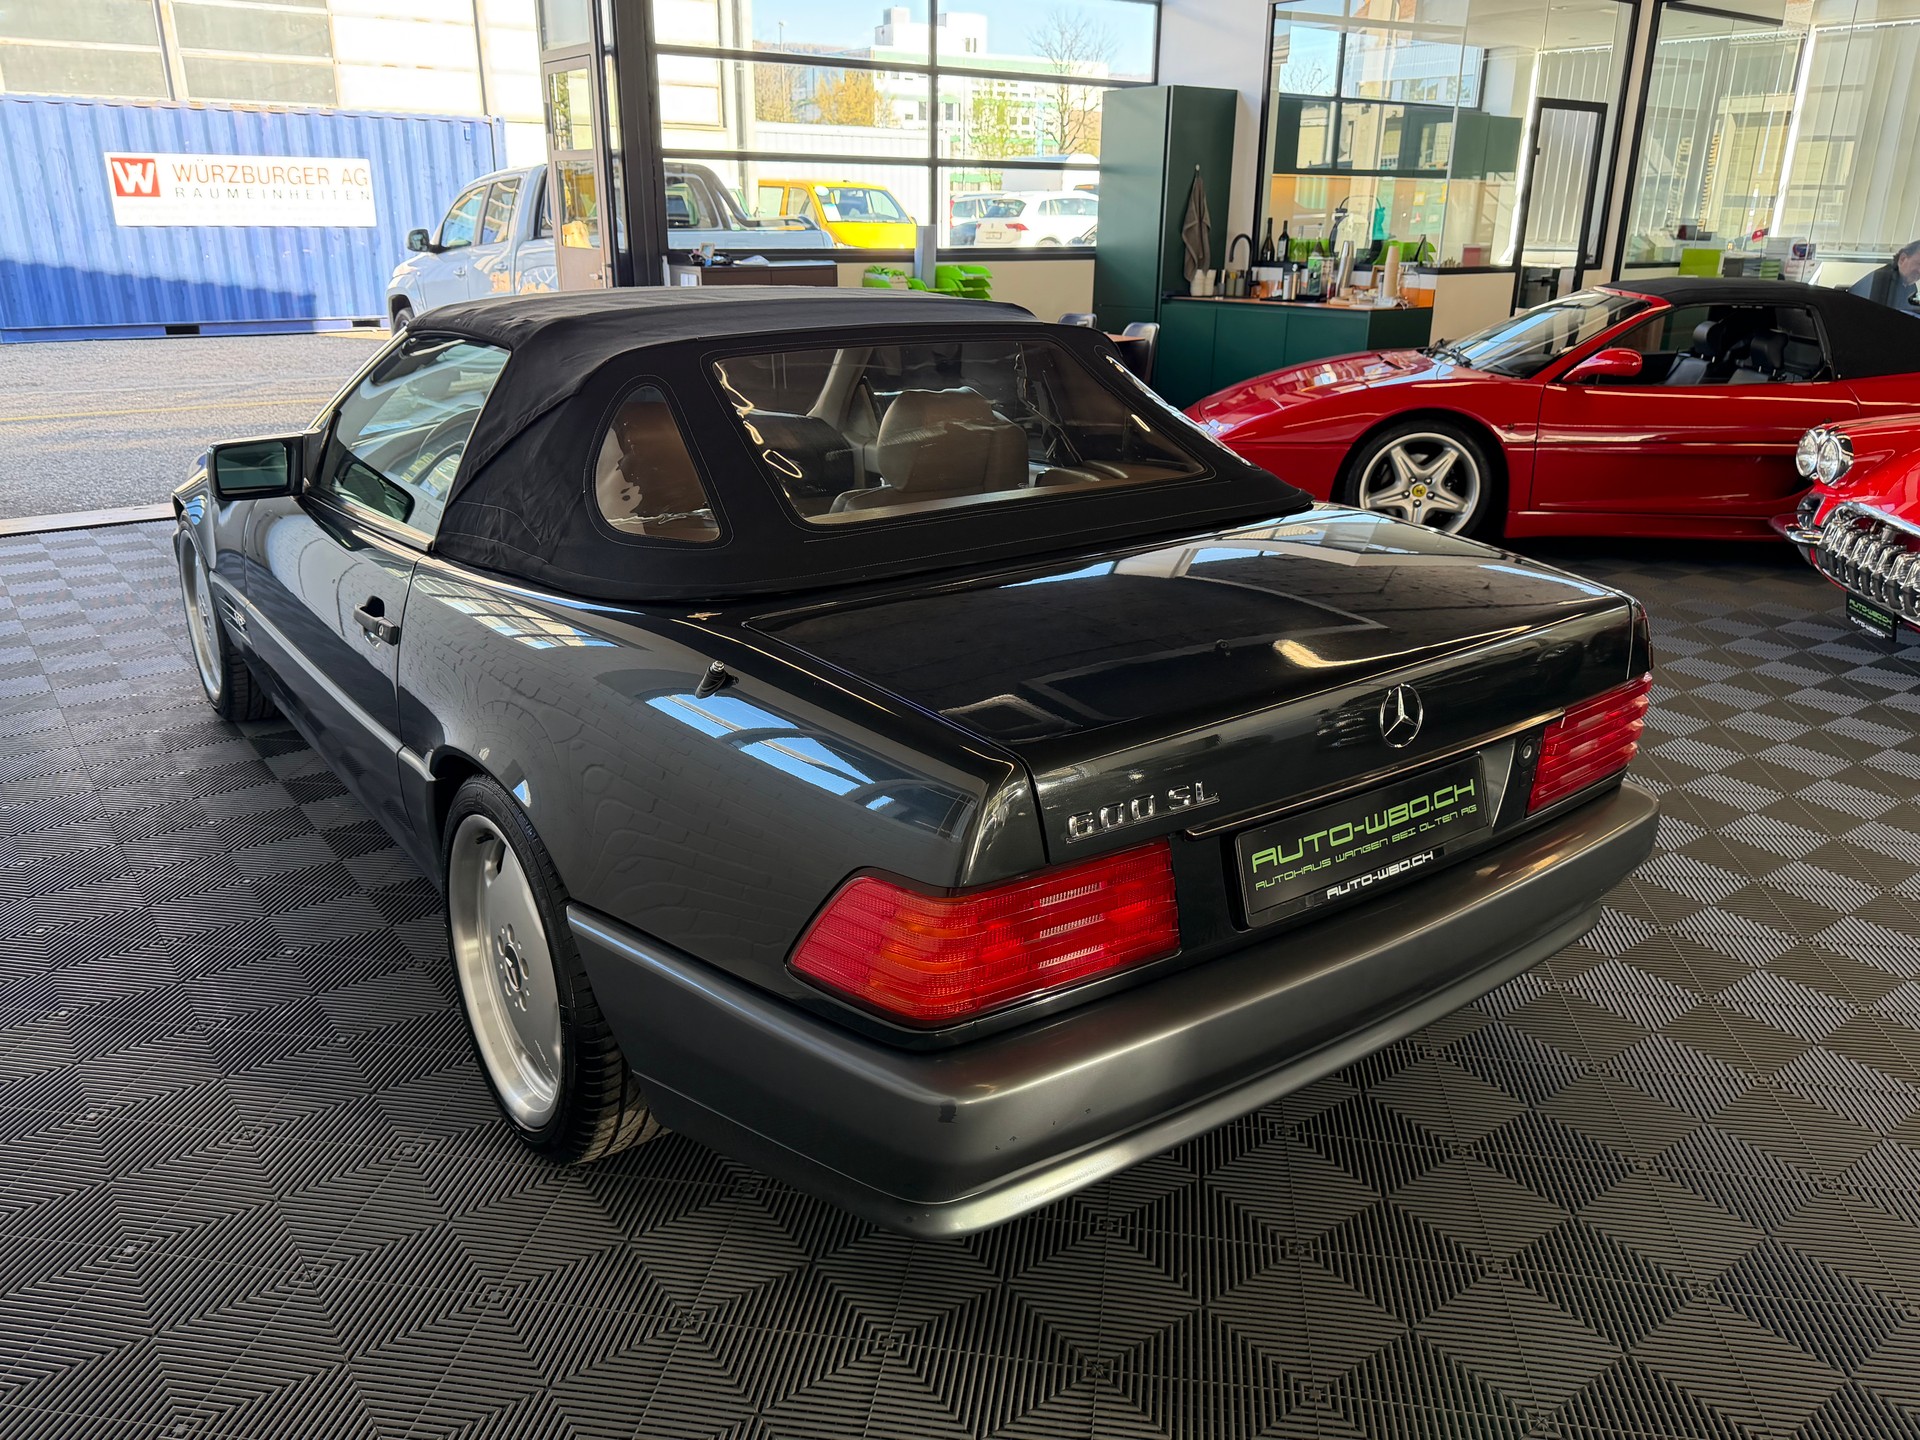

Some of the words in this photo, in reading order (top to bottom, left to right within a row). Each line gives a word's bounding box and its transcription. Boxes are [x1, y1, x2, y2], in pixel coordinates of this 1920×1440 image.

[111, 160, 156, 194] W
[171, 158, 331, 186] WÜRZBURGER
[341, 167, 369, 187] AG
[174, 186, 371, 201] RAUMEINHEITEN
[1067, 794, 1156, 838] 600
[1167, 781, 1220, 812] SL
[1251, 778, 1475, 873] AUTO-WBO.CH
[1255, 857, 1332, 891] AUTOHAUS
[1335, 838, 1389, 863] WANGEN
[1391, 828, 1417, 843] BEI
[1418, 811, 1458, 832] OLTEN
[1460, 803, 1477, 817] AG
[1326, 850, 1434, 900] AUTO-WBO.CH
